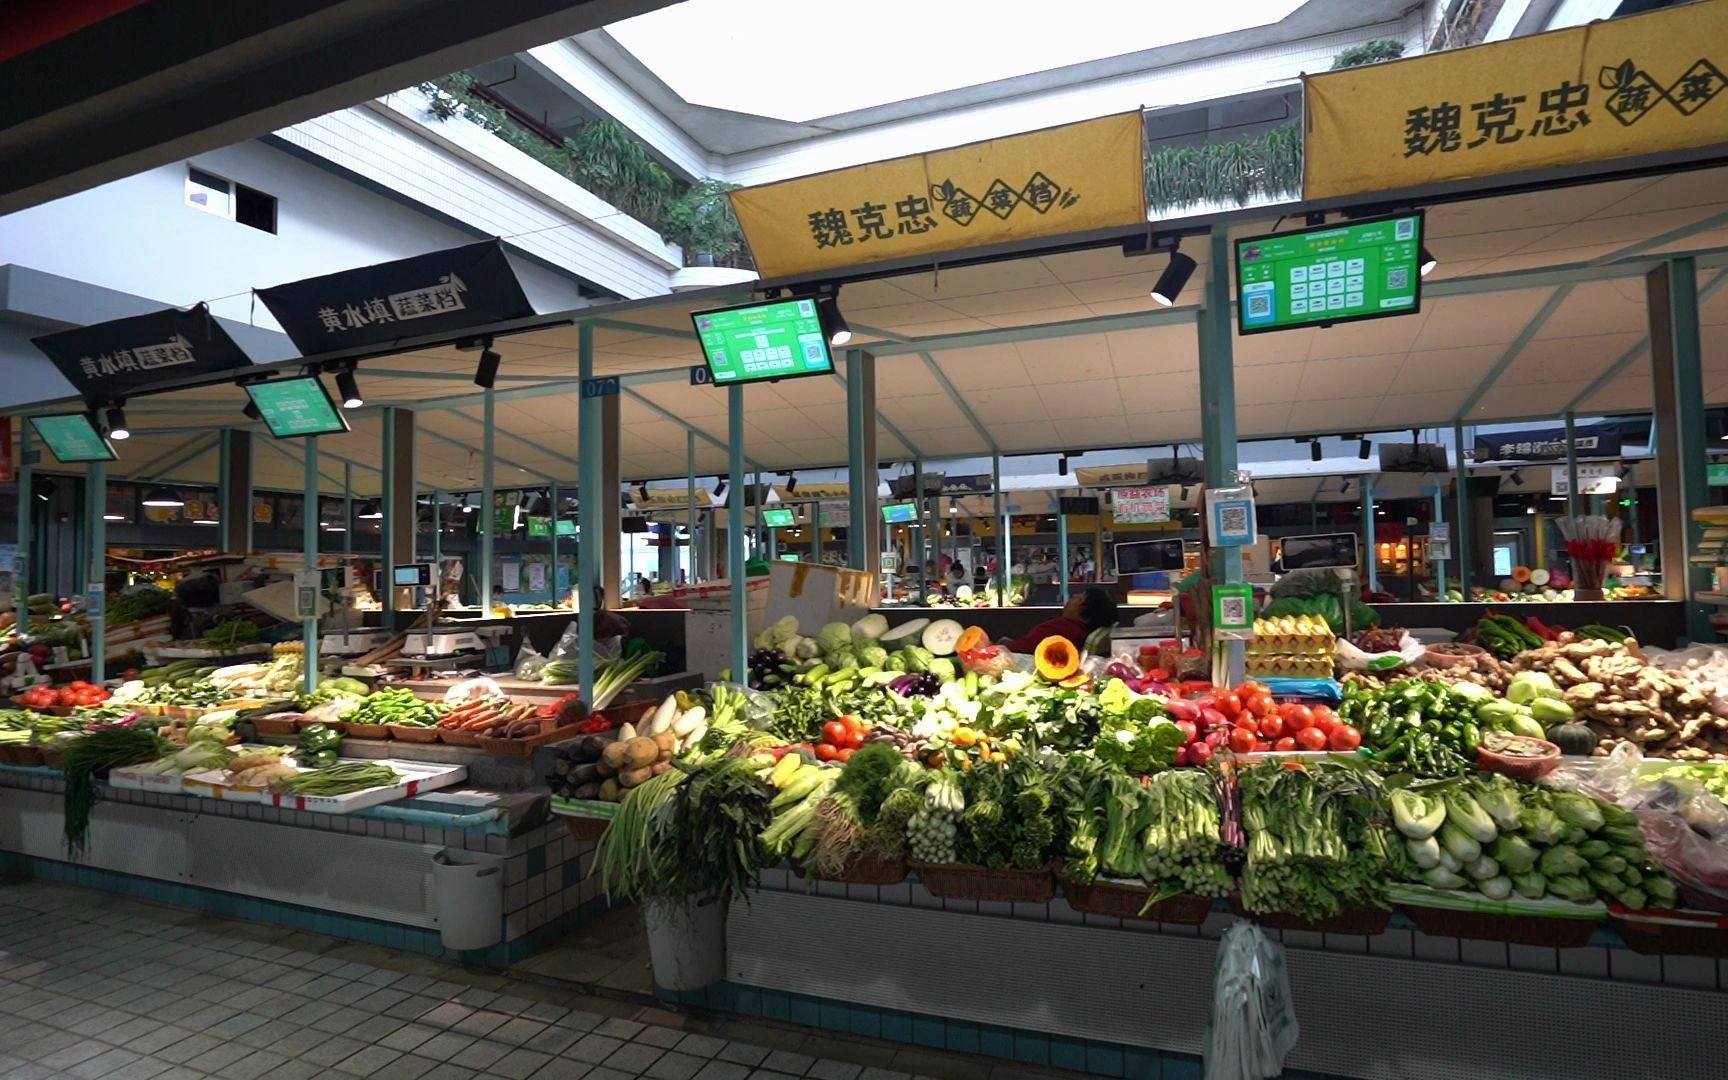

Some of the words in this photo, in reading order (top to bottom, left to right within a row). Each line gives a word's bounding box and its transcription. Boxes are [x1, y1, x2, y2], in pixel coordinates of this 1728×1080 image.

[1402, 80, 1592, 158] 魏克忠
[807, 194, 938, 249] 魏克忠
[949, 181, 1055, 220] 蔬菜档
[396, 287, 460, 318] 蔬菜档
